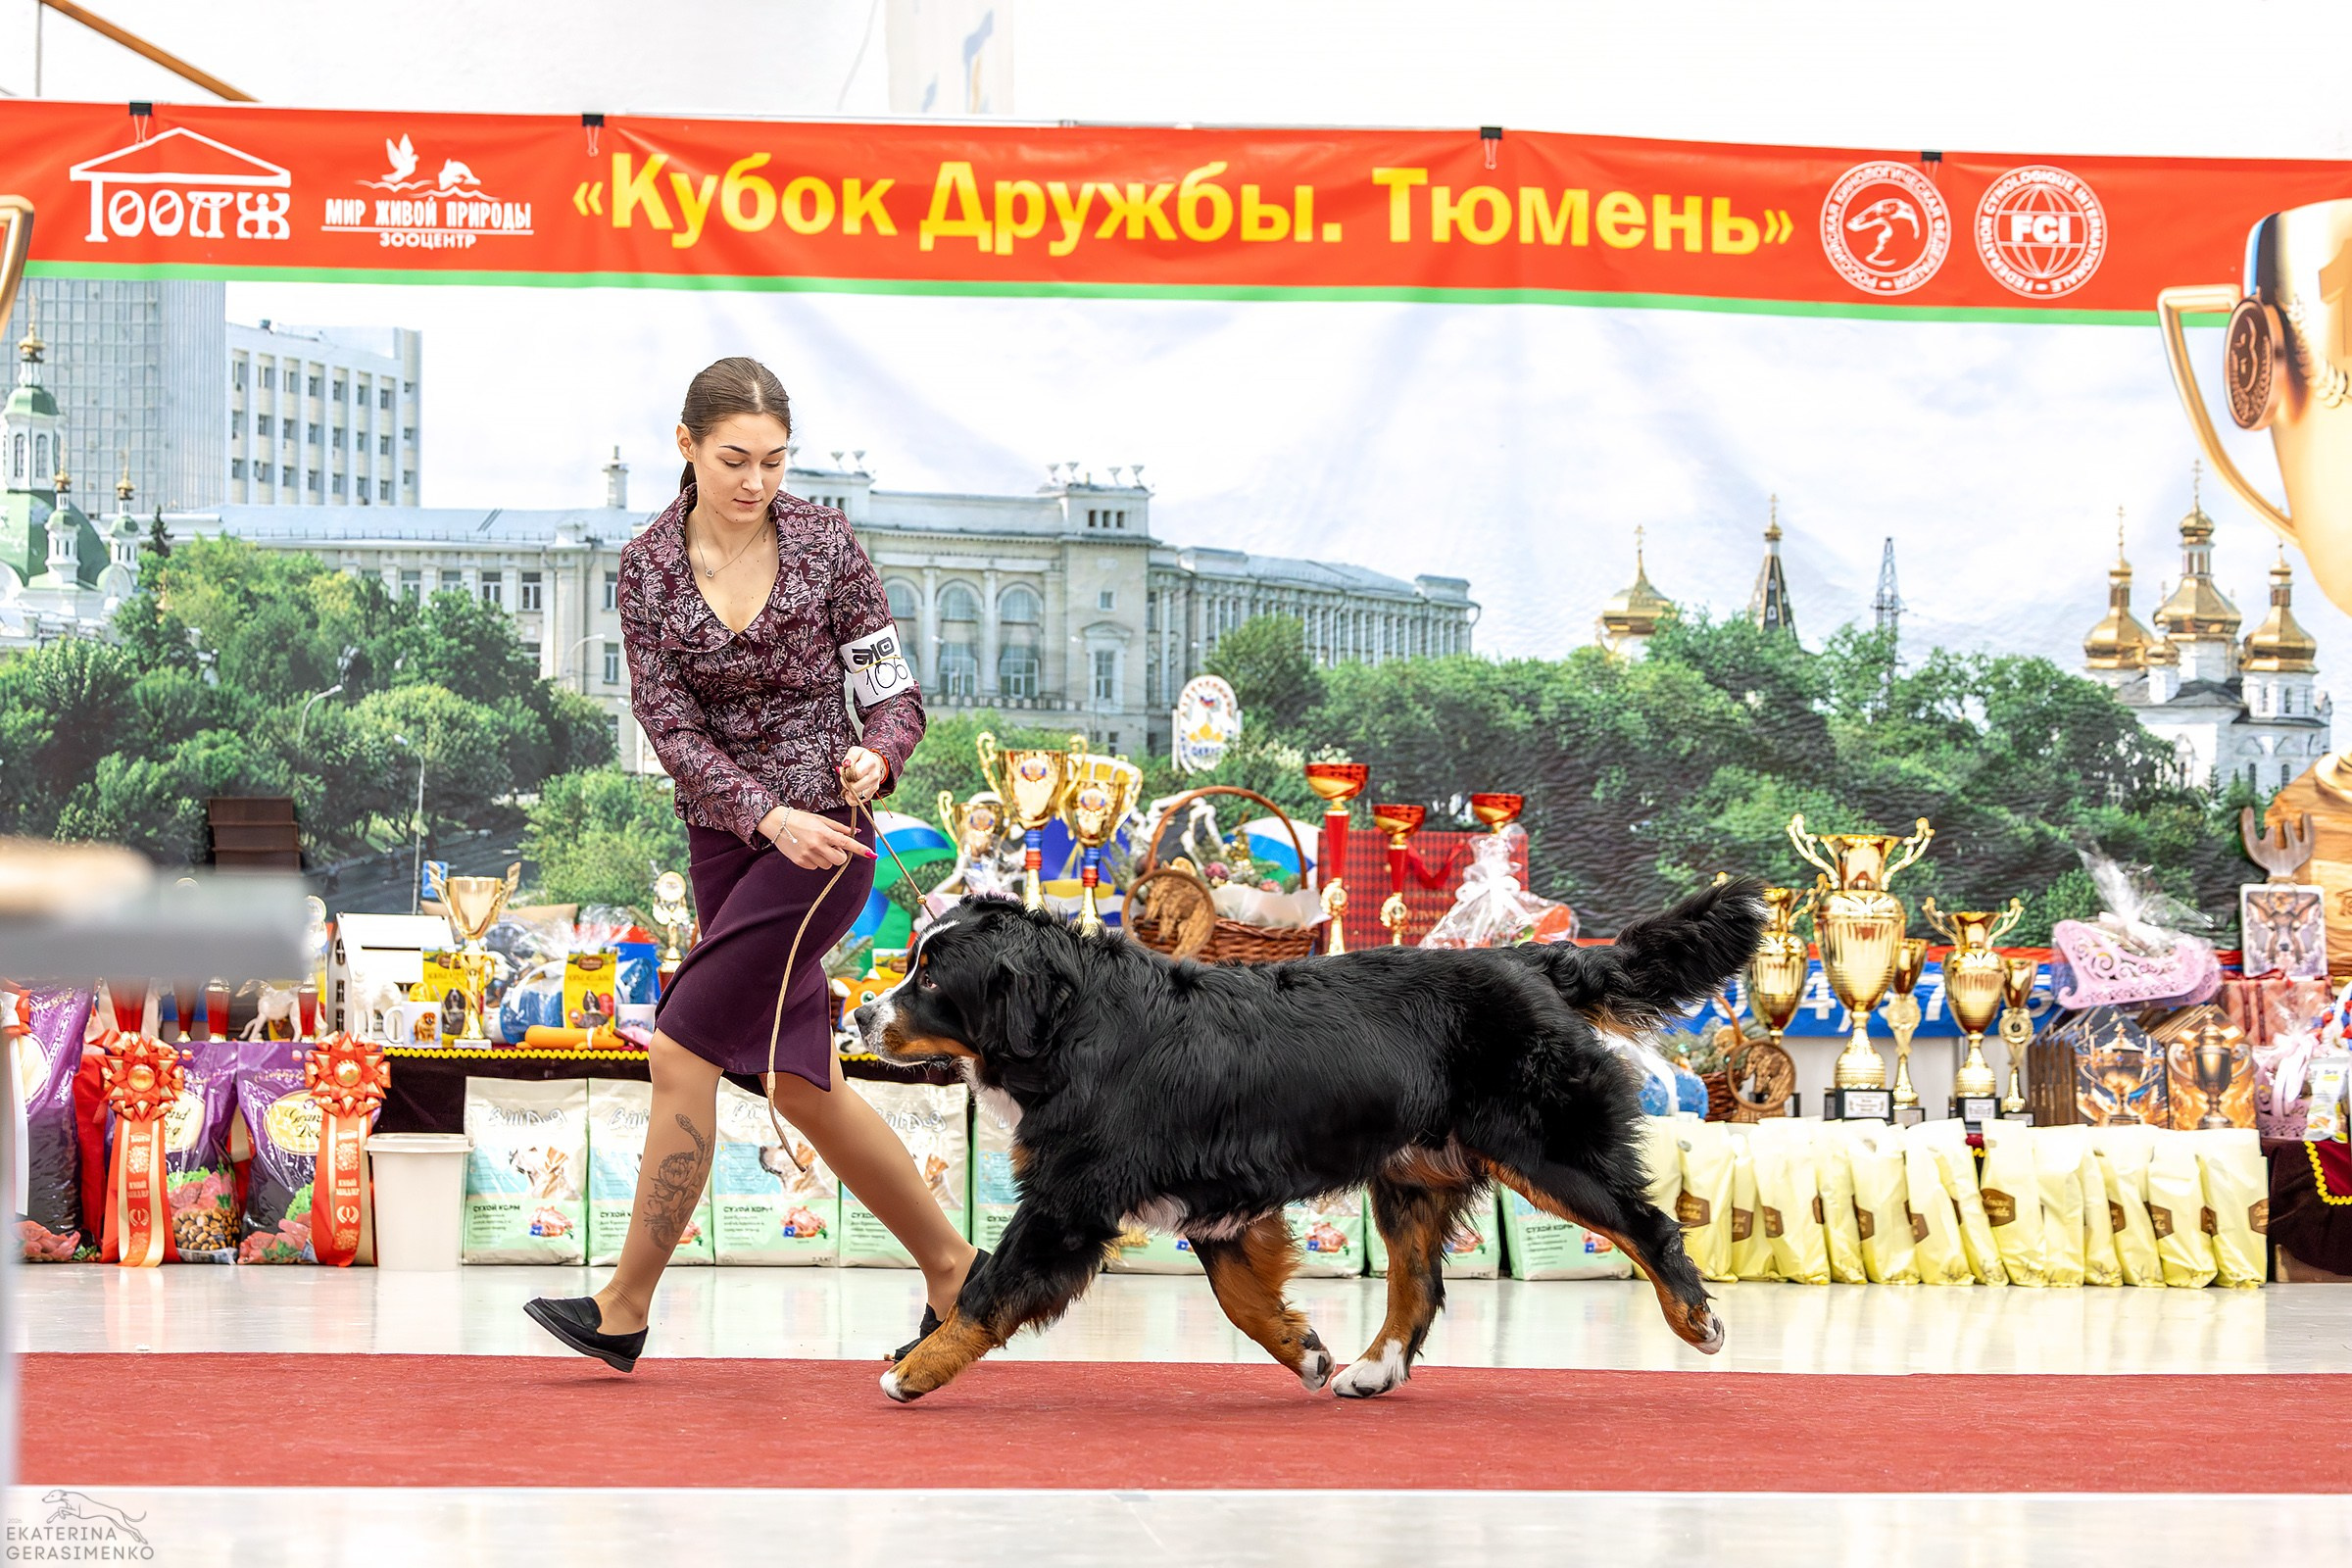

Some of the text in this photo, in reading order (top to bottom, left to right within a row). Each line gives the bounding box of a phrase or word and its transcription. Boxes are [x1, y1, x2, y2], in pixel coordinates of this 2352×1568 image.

[325, 196, 531, 230] МИР ЖИВОЙ ПРИРОДЫ
[572, 152, 1794, 256] «Кубок Дружбы. Тюмень»
[379, 232, 477, 250] ЗООЦЕНТР
[2011, 215, 2071, 243] FCI
